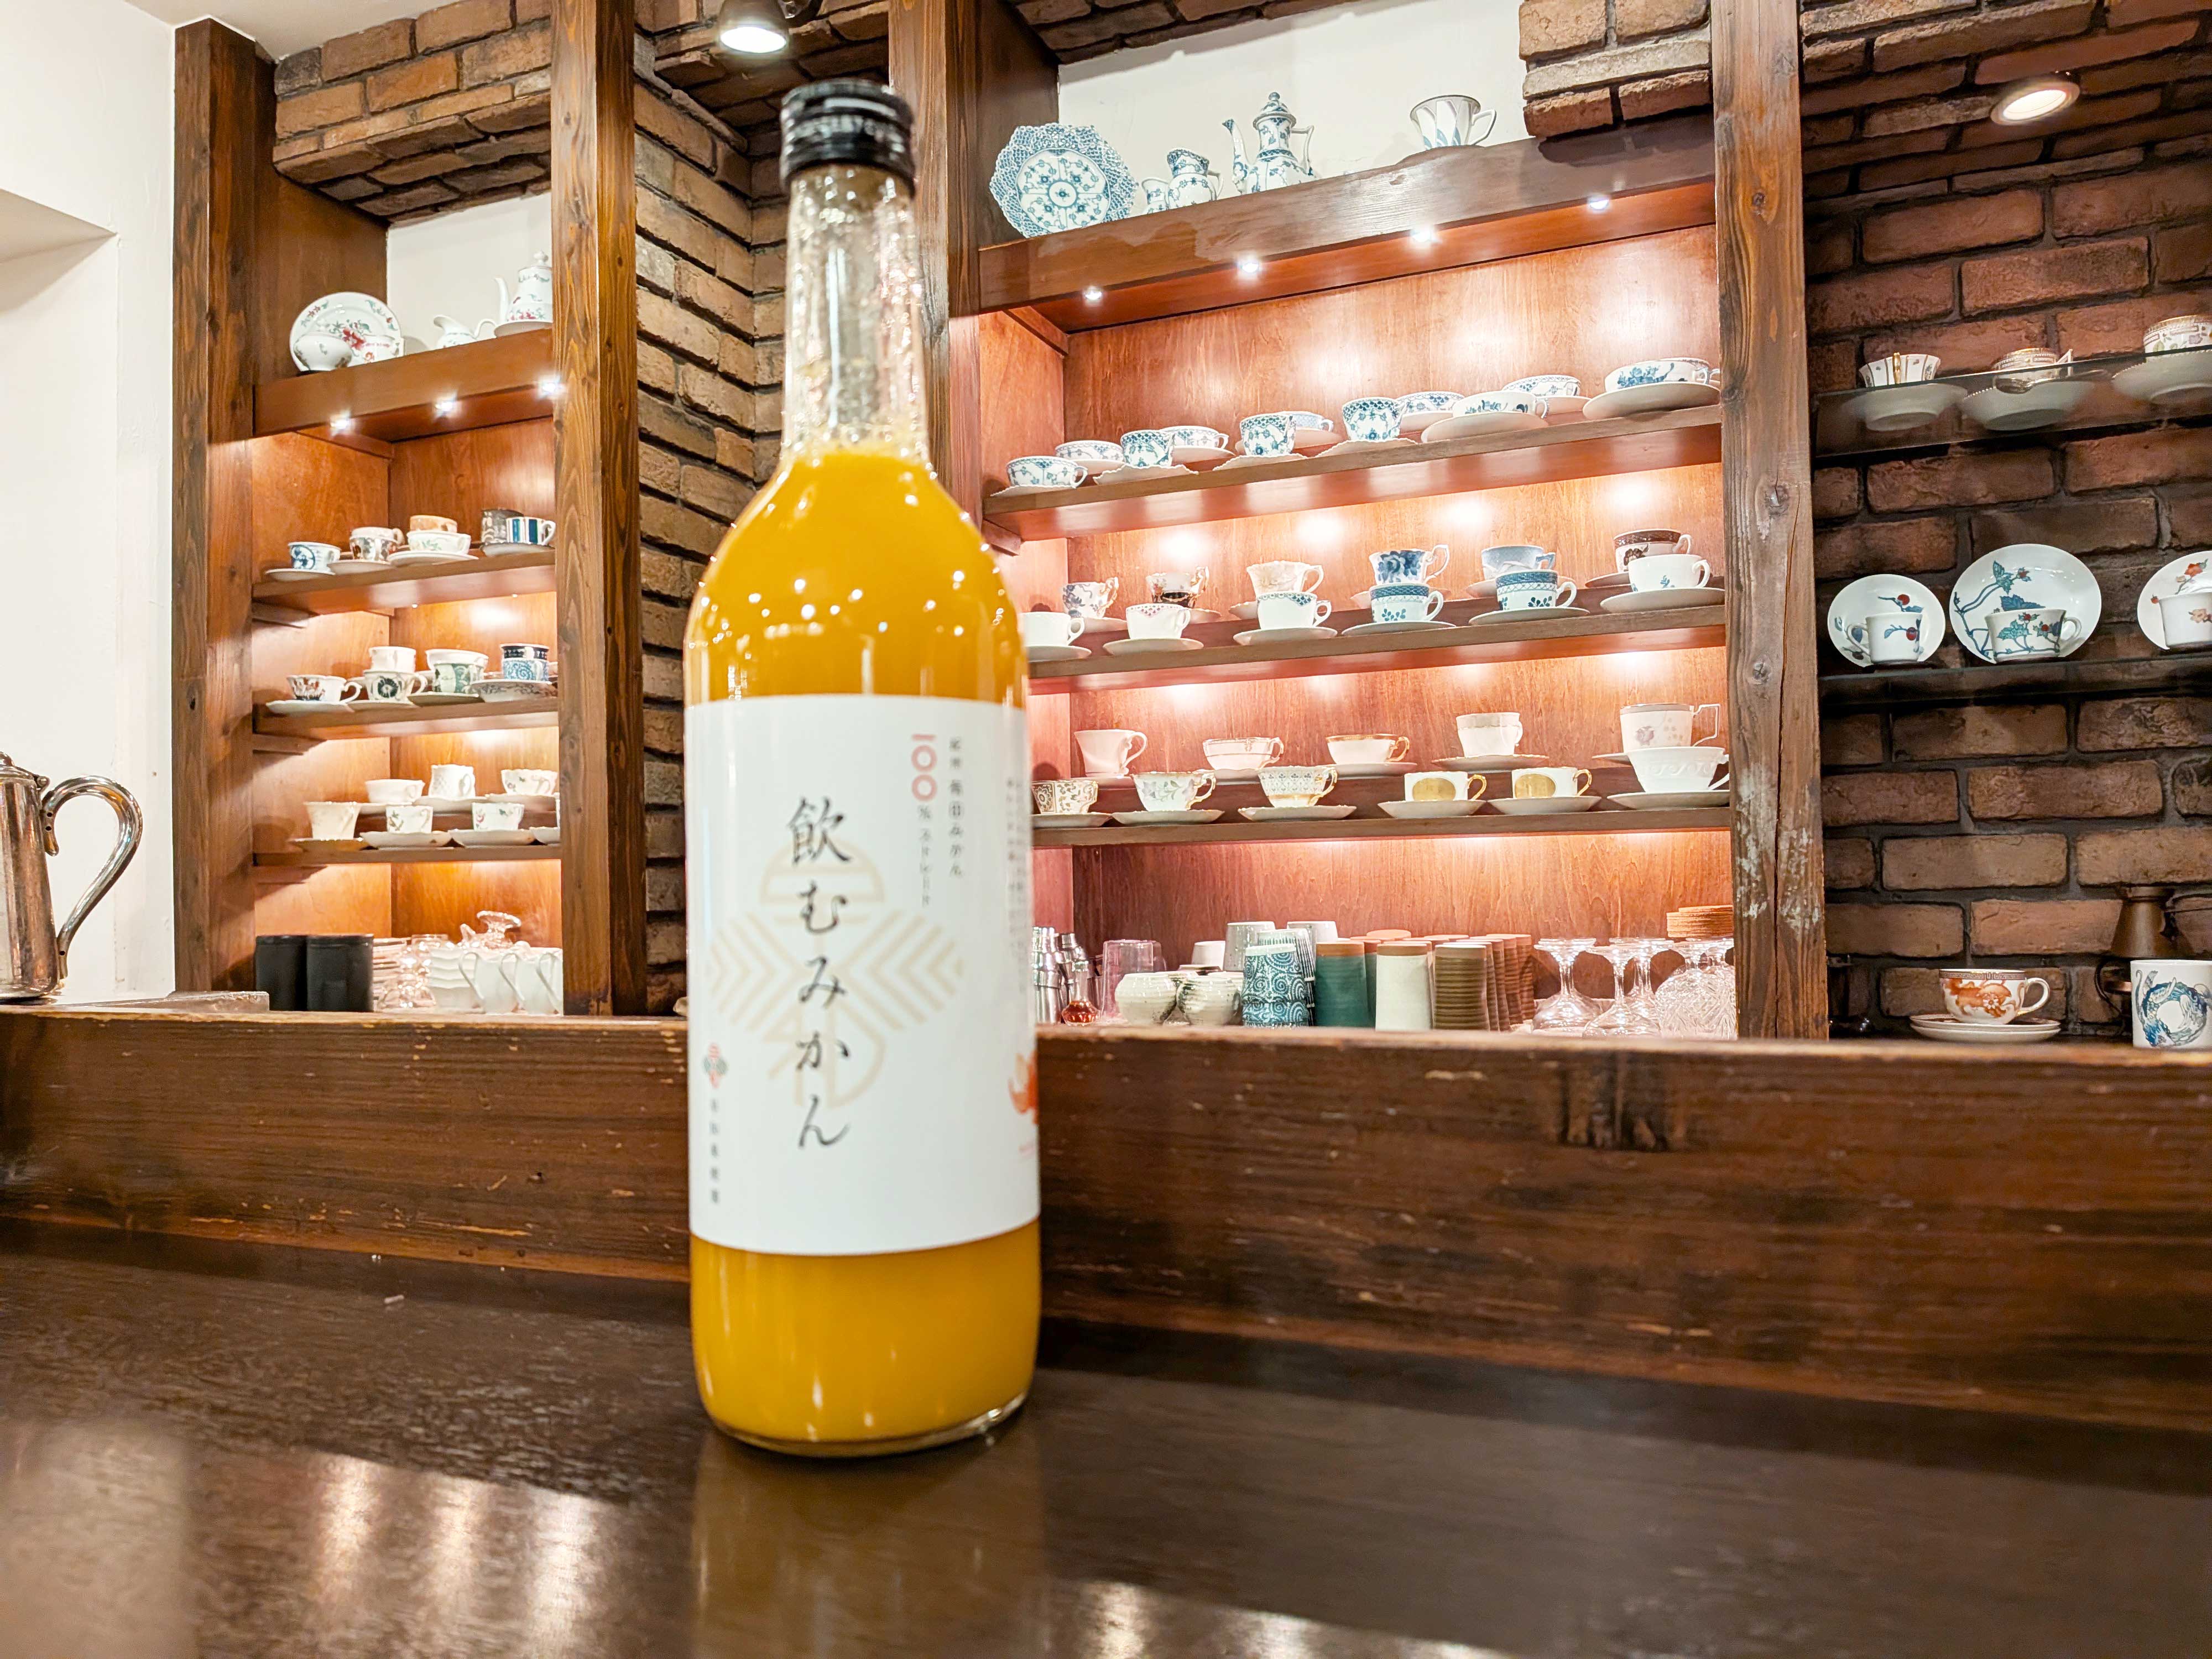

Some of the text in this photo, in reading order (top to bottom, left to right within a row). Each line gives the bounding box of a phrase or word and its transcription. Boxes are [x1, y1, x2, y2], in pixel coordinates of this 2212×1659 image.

[787, 796, 852, 1150] 飲むみかん
